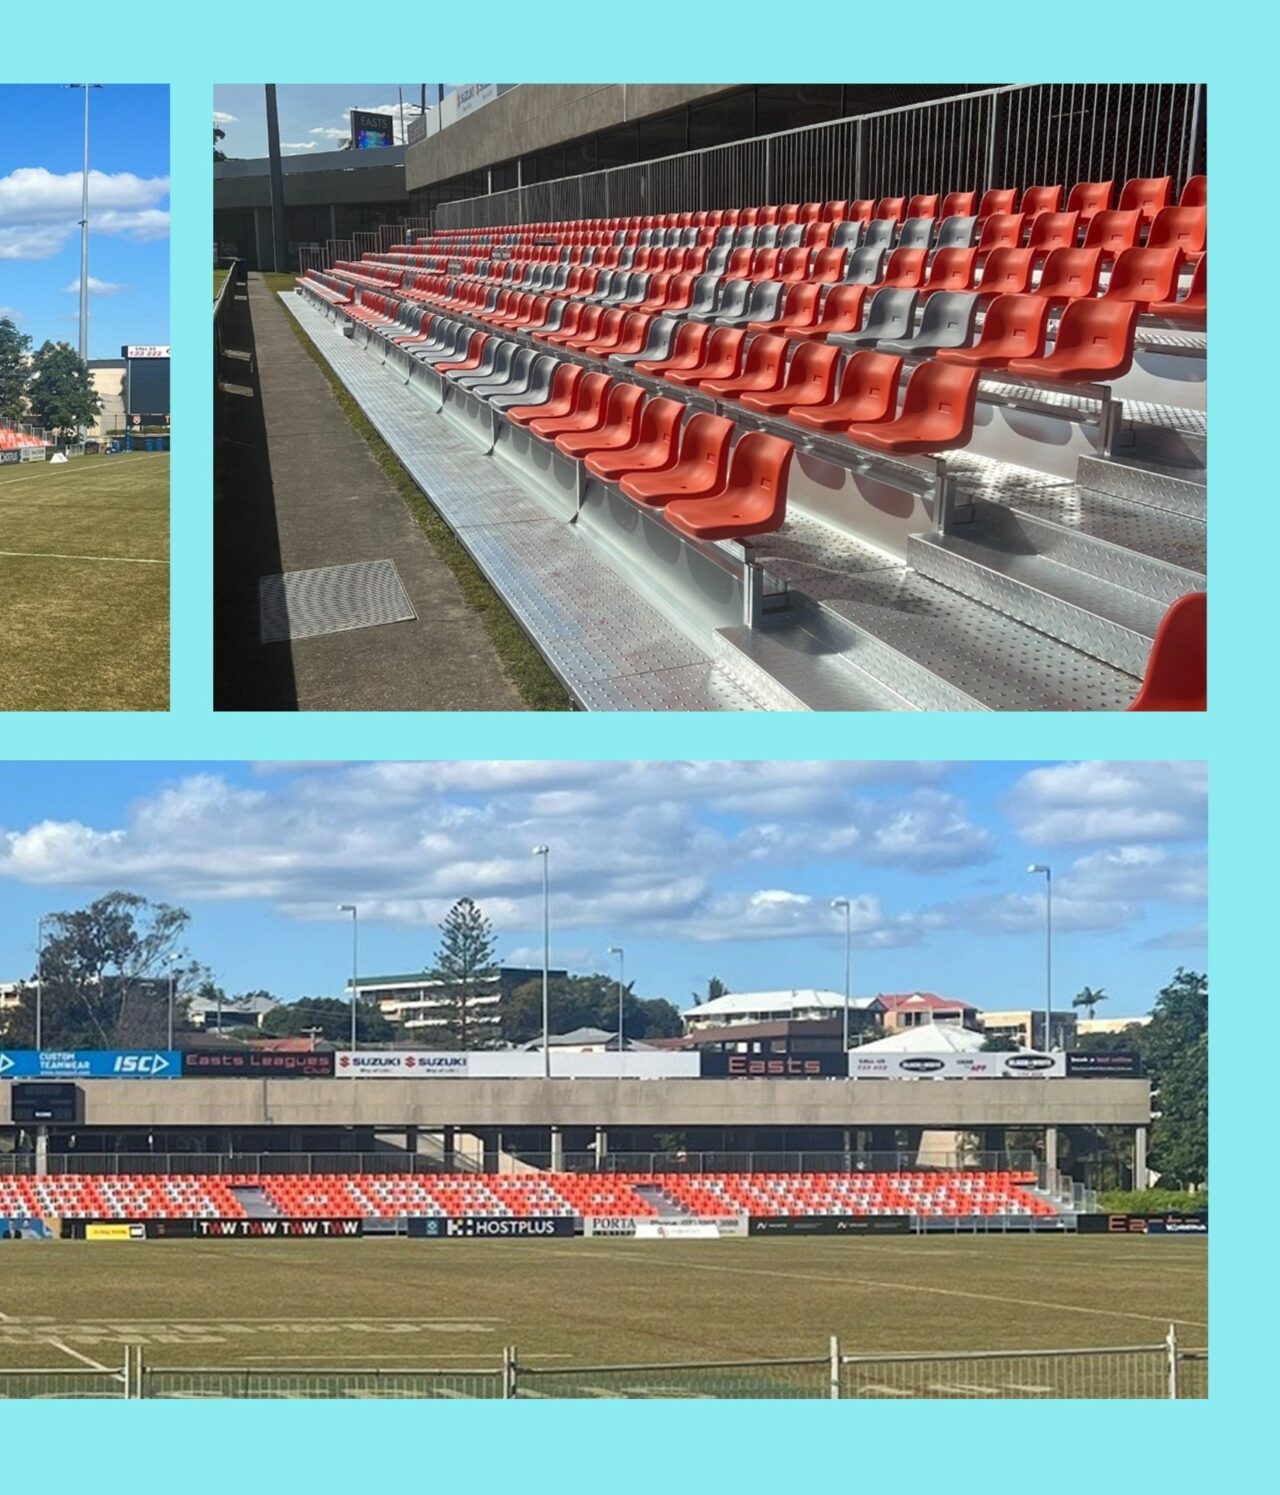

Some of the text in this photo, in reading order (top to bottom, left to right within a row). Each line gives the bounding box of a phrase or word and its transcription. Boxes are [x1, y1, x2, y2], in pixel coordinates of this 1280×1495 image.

[360, 116, 388, 128] EASTS
[186, 1054, 330, 1069] Easts Leagues
[354, 1057, 400, 1066] SUZUKI
[418, 1057, 466, 1066] SUZUKI
[728, 1056, 820, 1074] Easts
[303, 1066, 330, 1074] Club
[200, 1222, 358, 1234] TWW TWW TWW TWW
[476, 1220, 555, 1234] HOSTPLUS
[593, 1218, 636, 1228] PORTA
